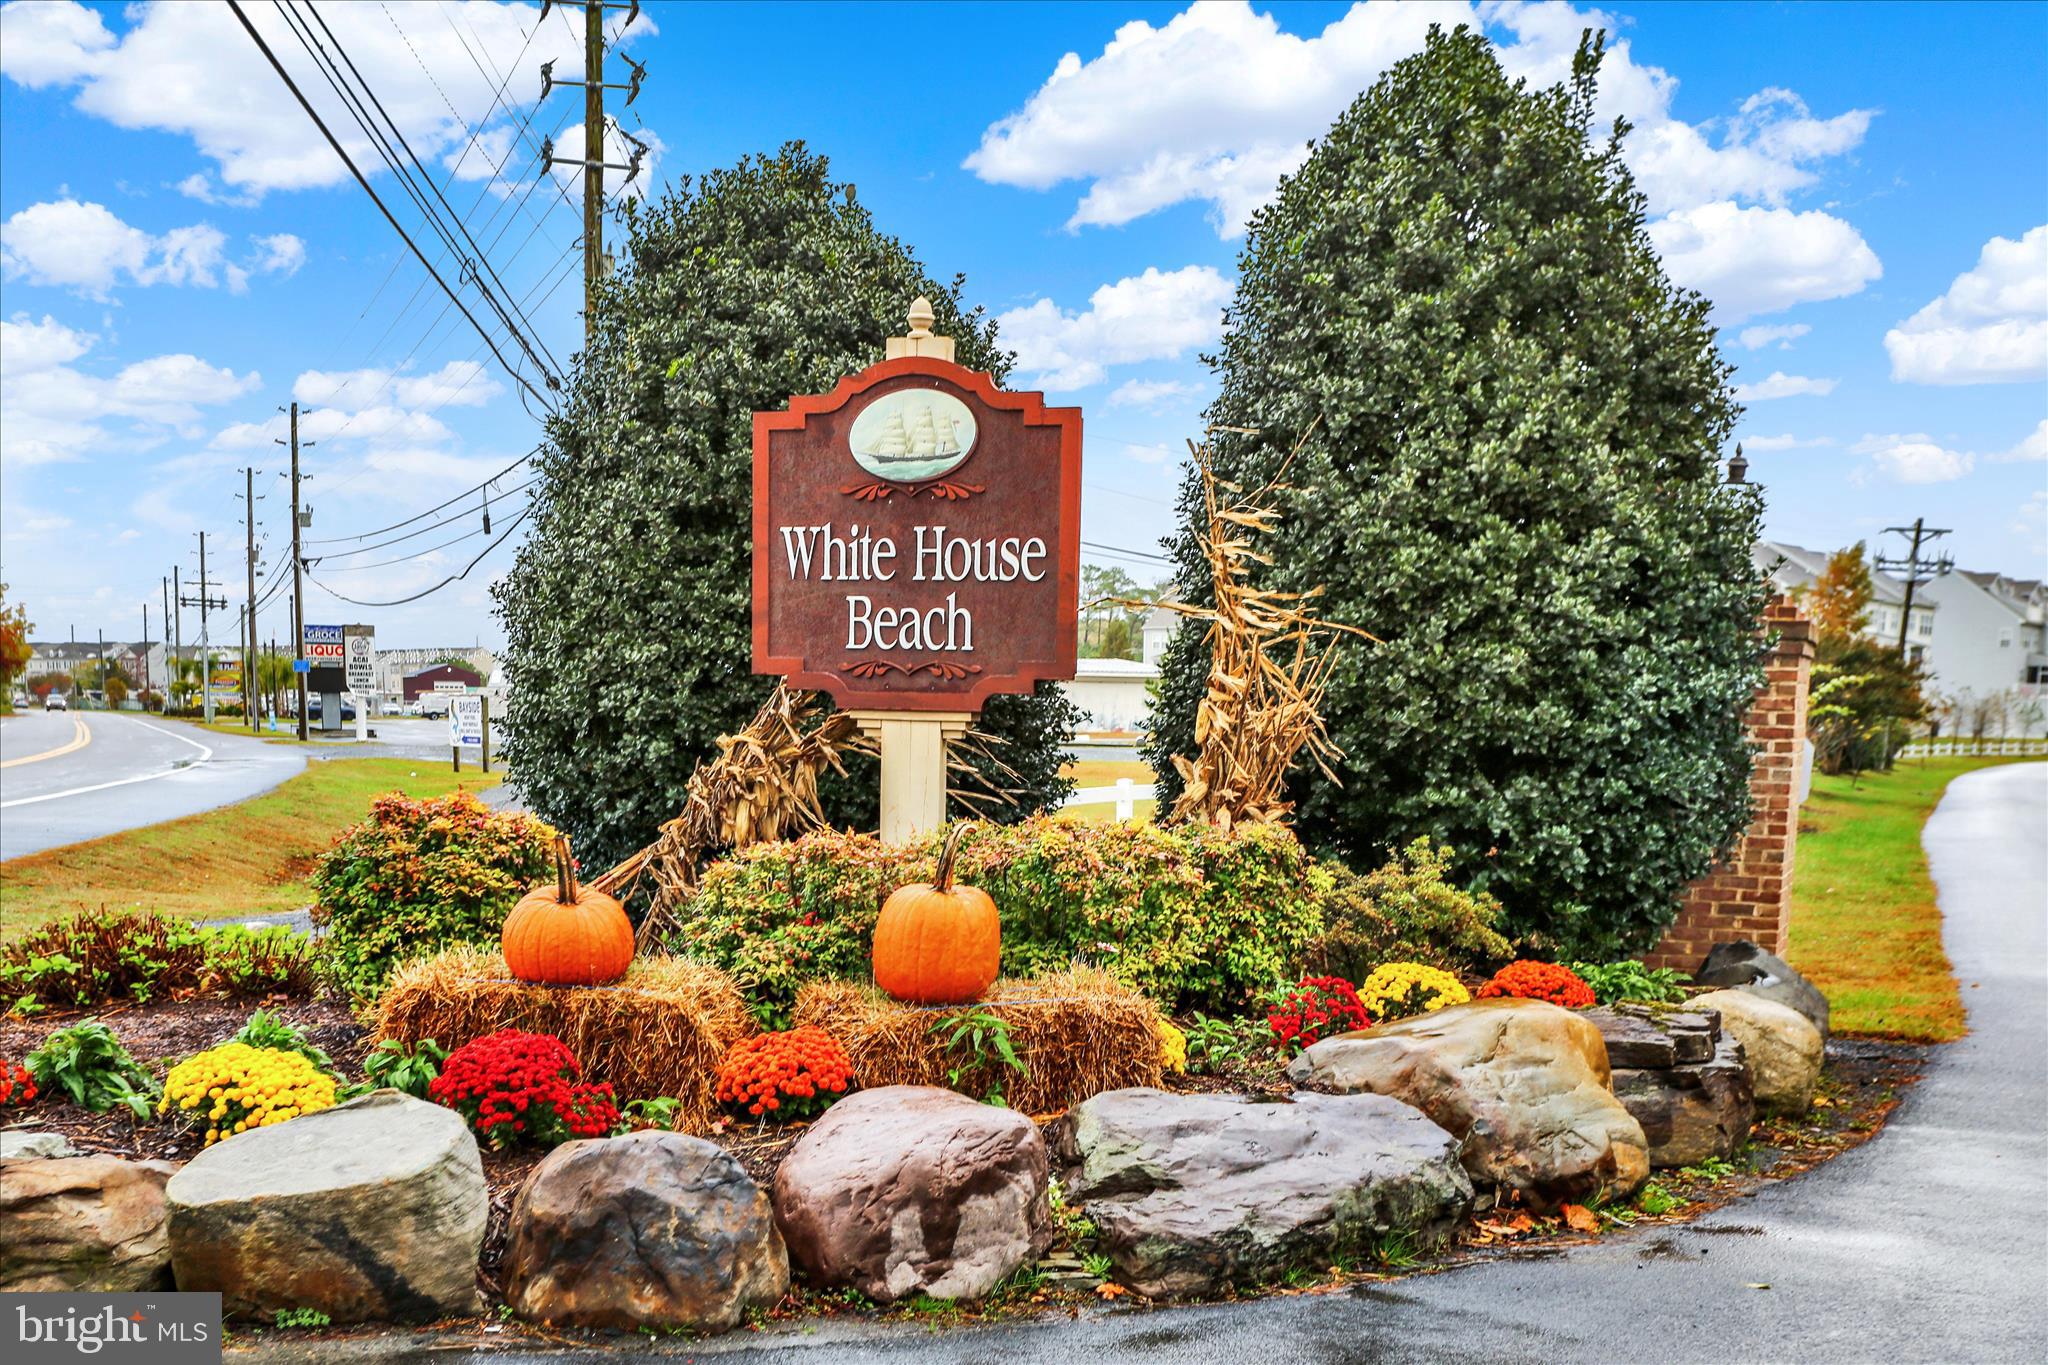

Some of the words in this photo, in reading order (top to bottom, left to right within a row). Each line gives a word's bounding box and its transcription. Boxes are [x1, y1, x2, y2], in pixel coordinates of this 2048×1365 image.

[780, 522, 897, 581] White
[912, 525, 1047, 581] House
[307, 631, 343, 639] GROCE
[845, 591, 974, 651] Beach
[459, 701, 480, 713] BAYSIDE
